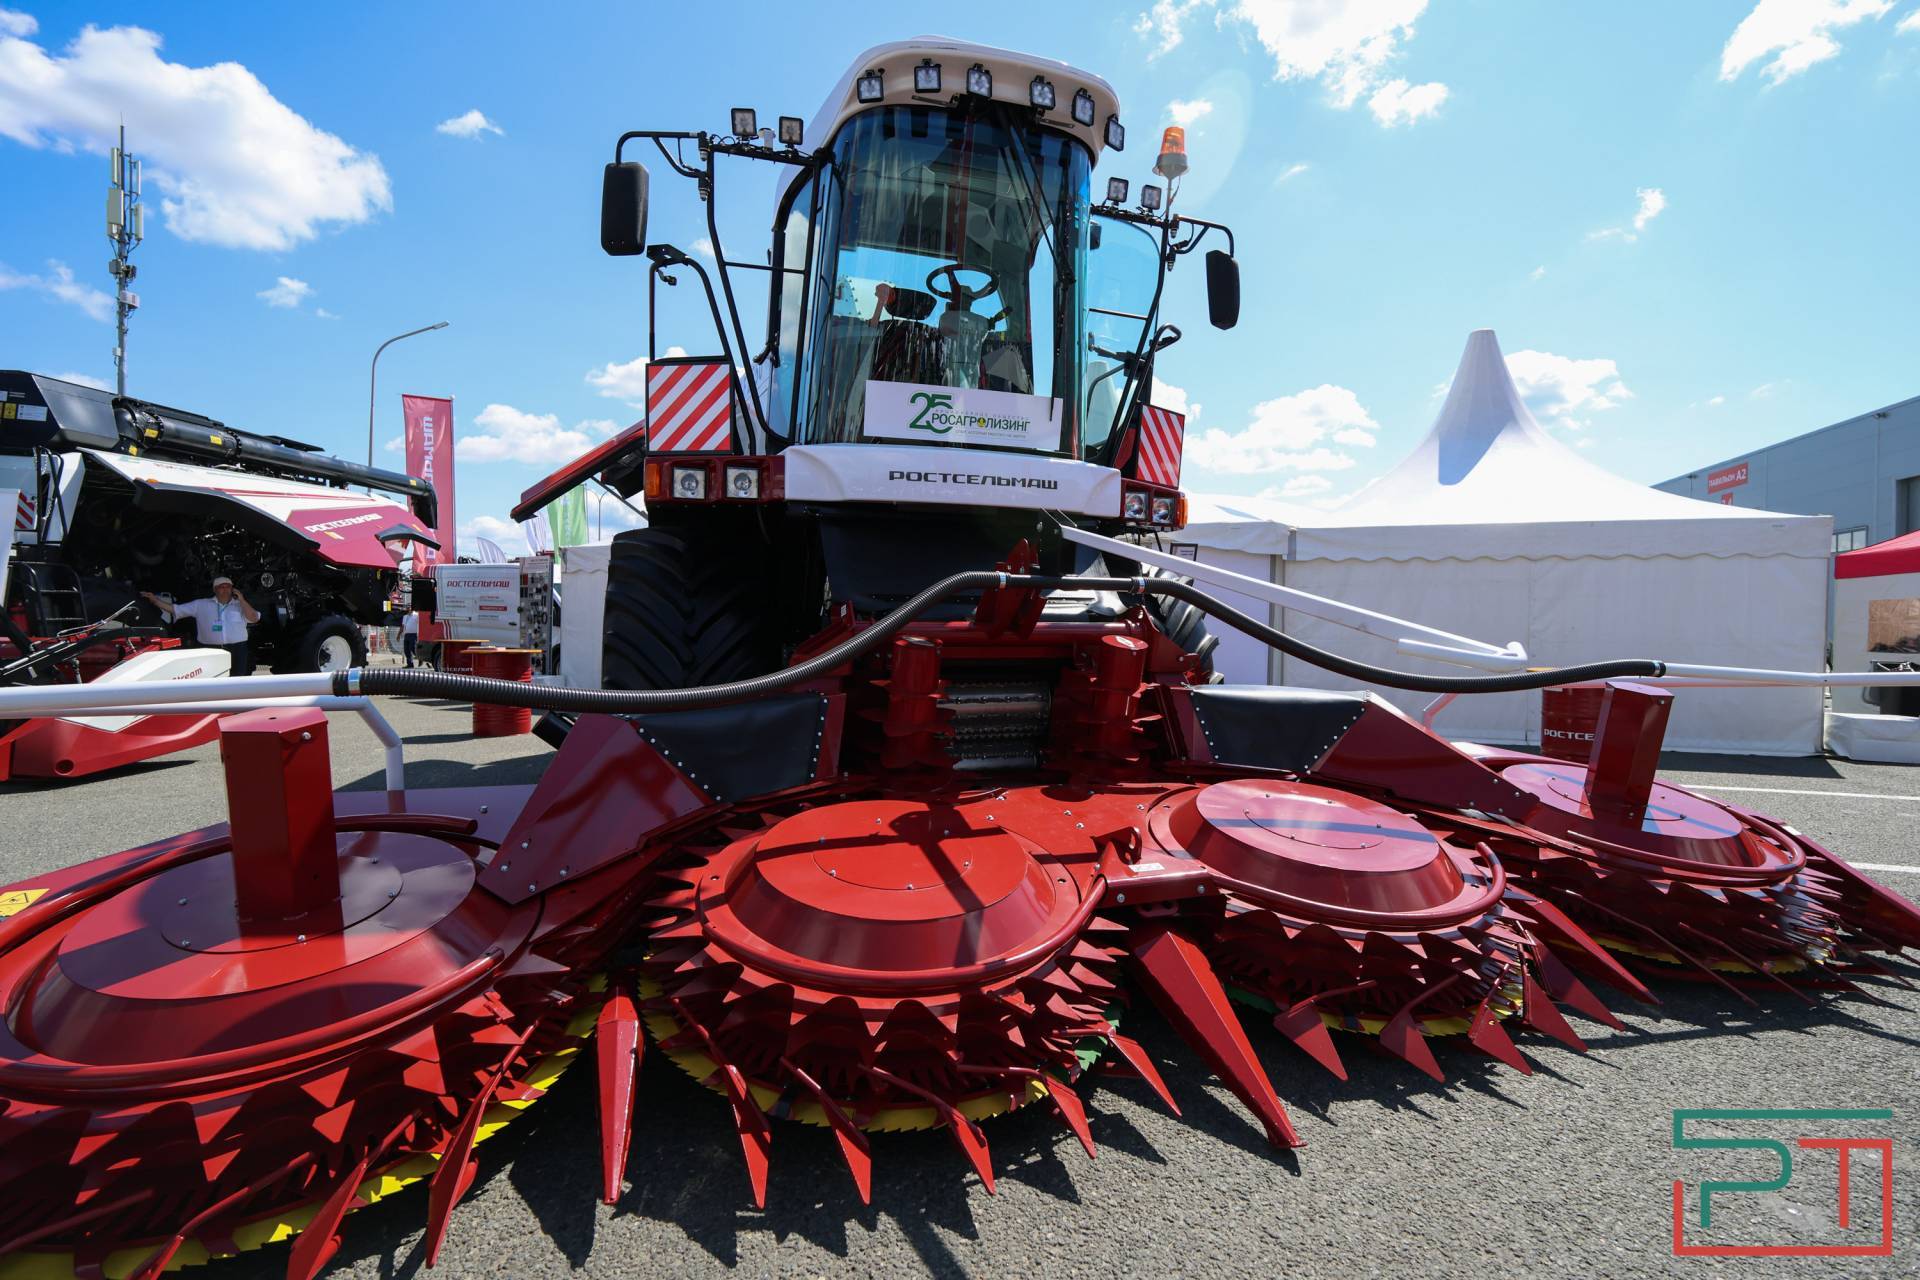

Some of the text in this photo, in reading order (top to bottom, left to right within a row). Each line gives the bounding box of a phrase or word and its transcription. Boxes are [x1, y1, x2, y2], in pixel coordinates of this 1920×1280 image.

[909, 391, 954, 434] 25
[931, 412, 1031, 433] РОСАГРОЛИЗИНГ
[889, 470, 1058, 490] РОСТСЕЛЬМАШ
[447, 580, 510, 588] РОСТСЕЛЬМАШ
